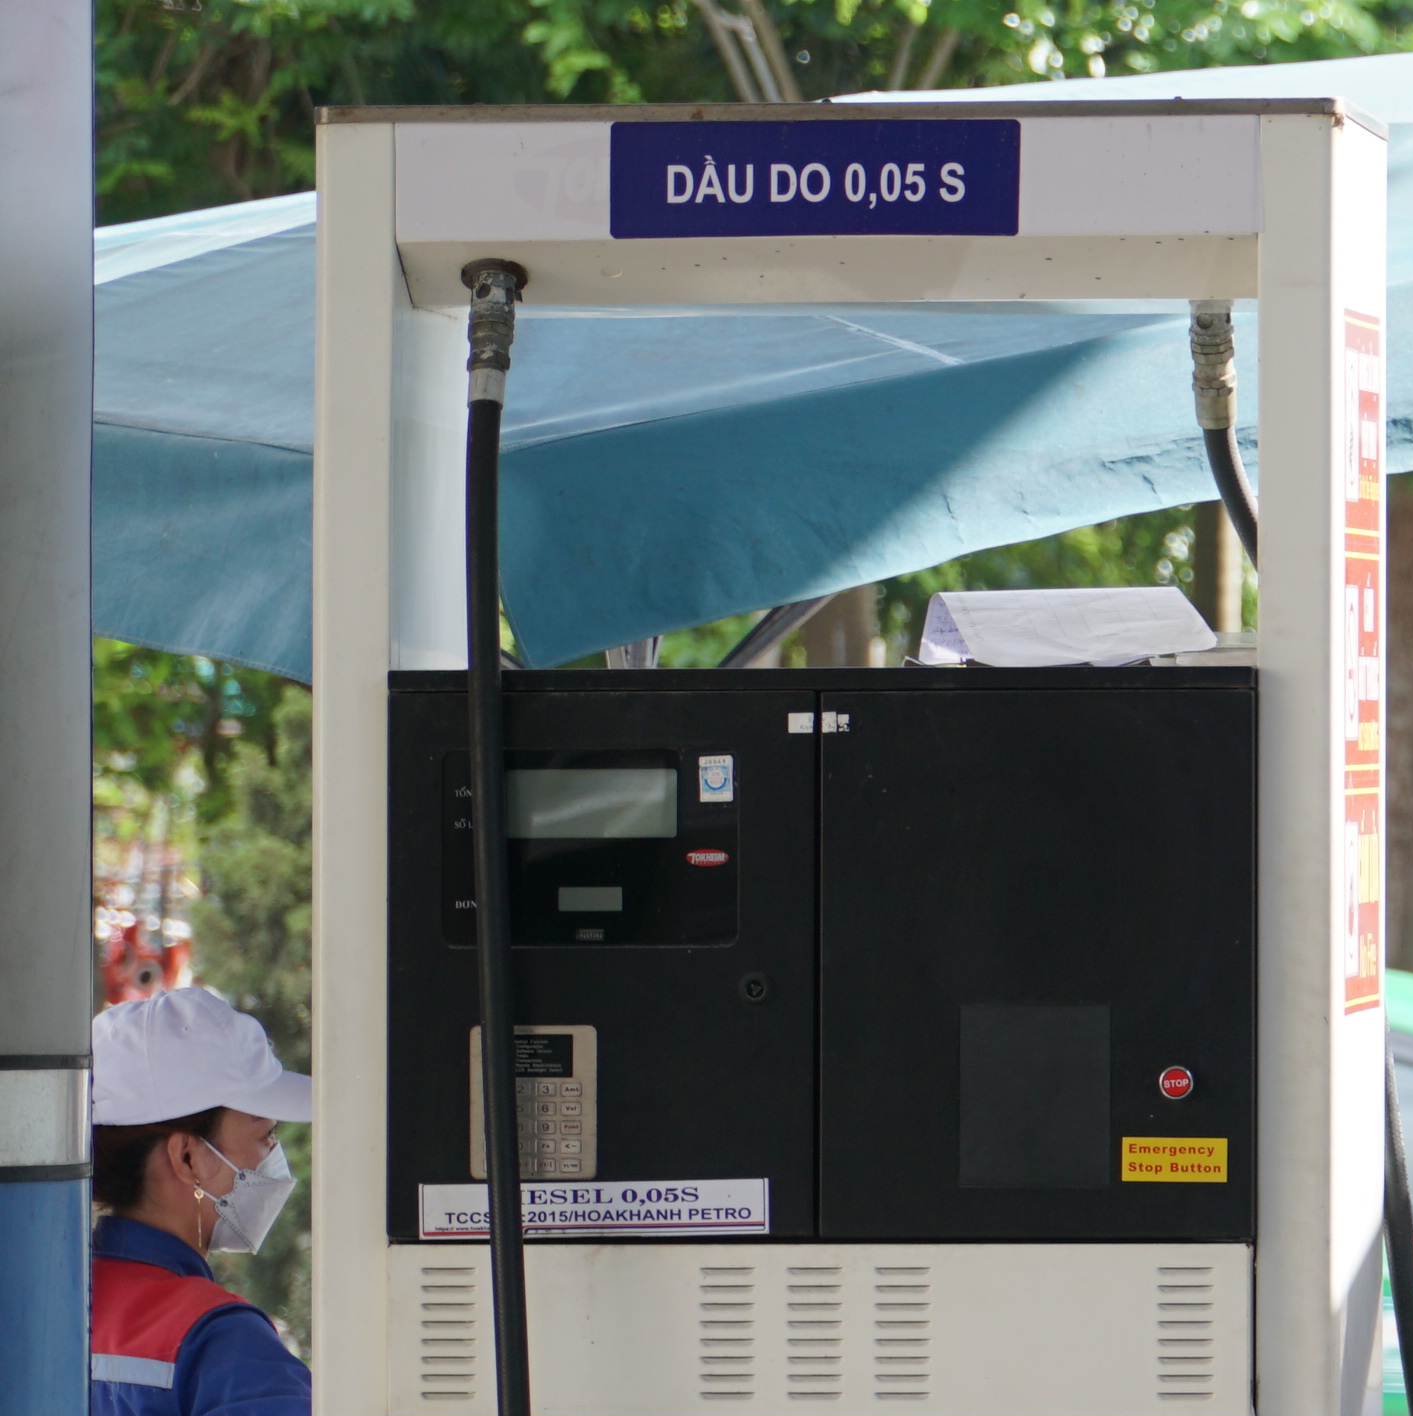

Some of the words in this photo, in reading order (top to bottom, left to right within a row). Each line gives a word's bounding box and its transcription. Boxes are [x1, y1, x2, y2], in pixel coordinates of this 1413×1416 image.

[666, 155, 755, 204] DẦU
[769, 163, 832, 203] DO
[844, 162, 927, 209] 0,05
[938, 162, 967, 203] S
[542, 1085, 549, 1094] 3
[1163, 1078, 1190, 1089] STOP
[542, 1104, 549, 1113] 6
[542, 1123, 549, 1132] 9
[1128, 1143, 1215, 1157] Emergency
[1128, 1162, 1163, 1175] Stop
[1169, 1162, 1222, 1173] Button
[521, 1188, 613, 1206] ESEL
[621, 1186, 699, 1206] 0,05S
[521, 1208, 682, 1223] :2015/HOAKHANH
[688, 1207, 752, 1221] PETRO
